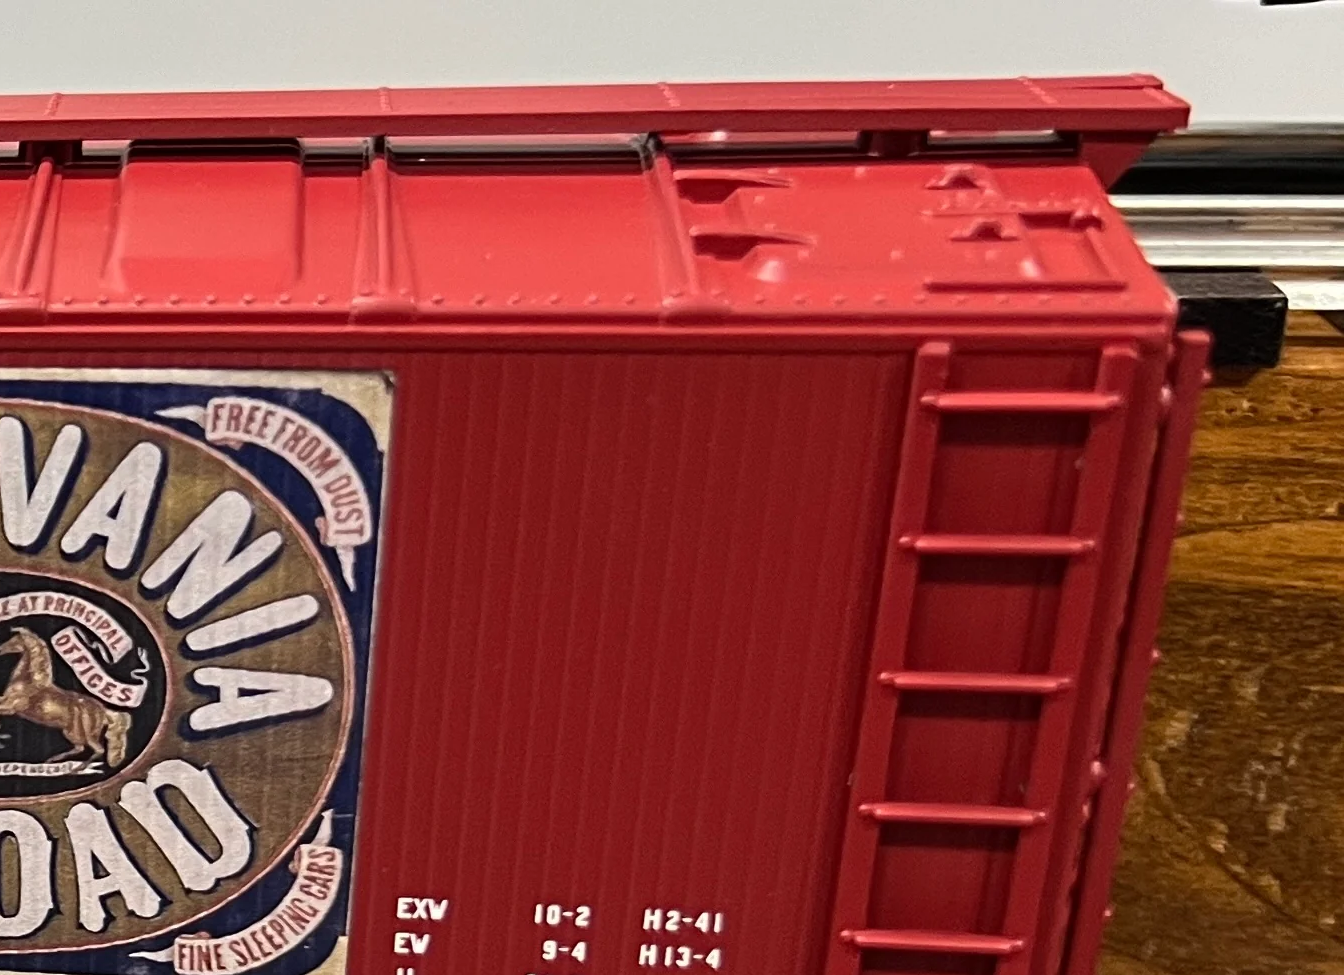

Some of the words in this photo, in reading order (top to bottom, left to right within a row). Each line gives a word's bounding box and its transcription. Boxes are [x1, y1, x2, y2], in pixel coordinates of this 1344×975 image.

[212, 402, 276, 439] FREE
[271, 416, 341, 479] FROM
[323, 473, 363, 537] DUST
[17, 595, 40, 614] AT
[44, 595, 125, 651] PRINCIPAL
[55, 634, 135, 702] OFFICES
[178, 943, 226, 972] FINE
[229, 898, 320, 967] SLEEPING
[299, 848, 336, 900] CARS
[396, 897, 448, 920] EXW
[534, 904, 591, 927] 10-2
[394, 932, 431, 955] EW
[542, 940, 588, 963] 9-4
